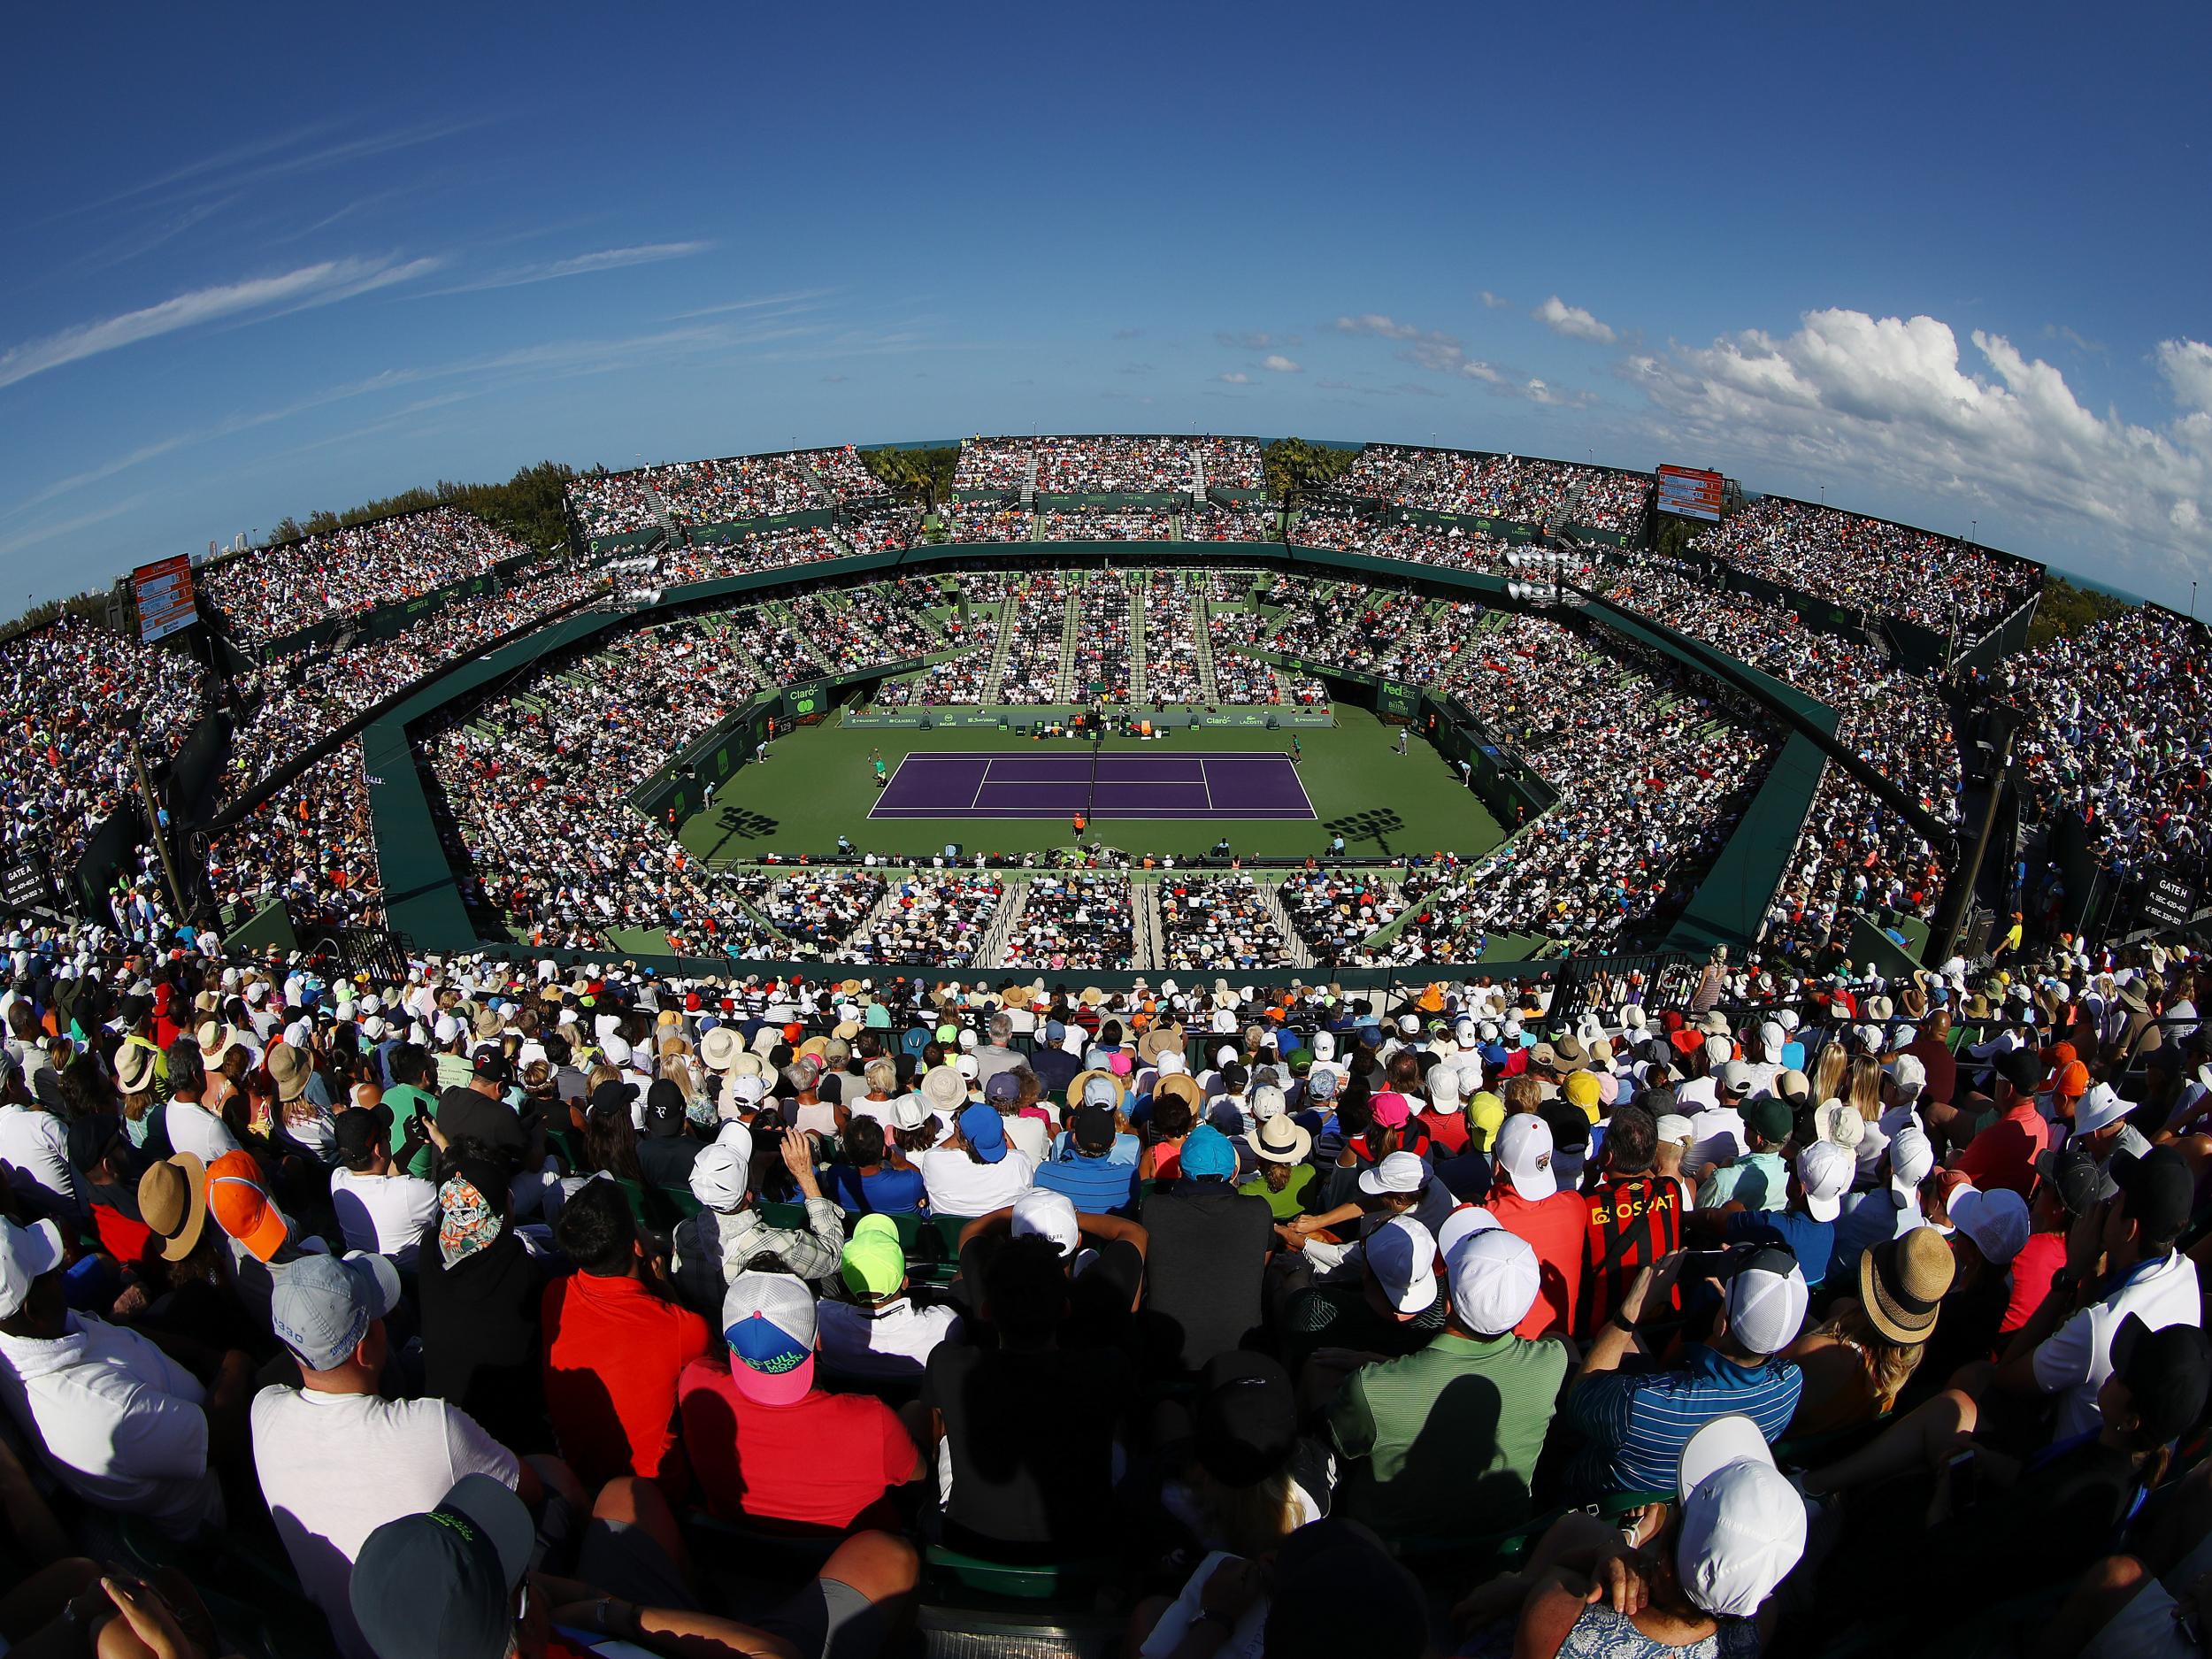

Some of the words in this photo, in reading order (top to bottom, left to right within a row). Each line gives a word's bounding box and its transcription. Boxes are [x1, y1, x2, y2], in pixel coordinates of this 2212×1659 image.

[1260, 492, 1266, 501] E
[590, 541, 599, 550] C
[789, 687, 817, 701] Claro
[1383, 682, 1416, 700] FedEx
[8, 867, 27, 881] GATE
[27, 864, 33, 874] A
[2159, 879, 2181, 895] GATE
[2179, 888, 2188, 899] H
[764, 1350, 797, 1367] FULL
[766, 1354, 804, 1371] MOON
[769, 1365, 793, 1374] PARTY
